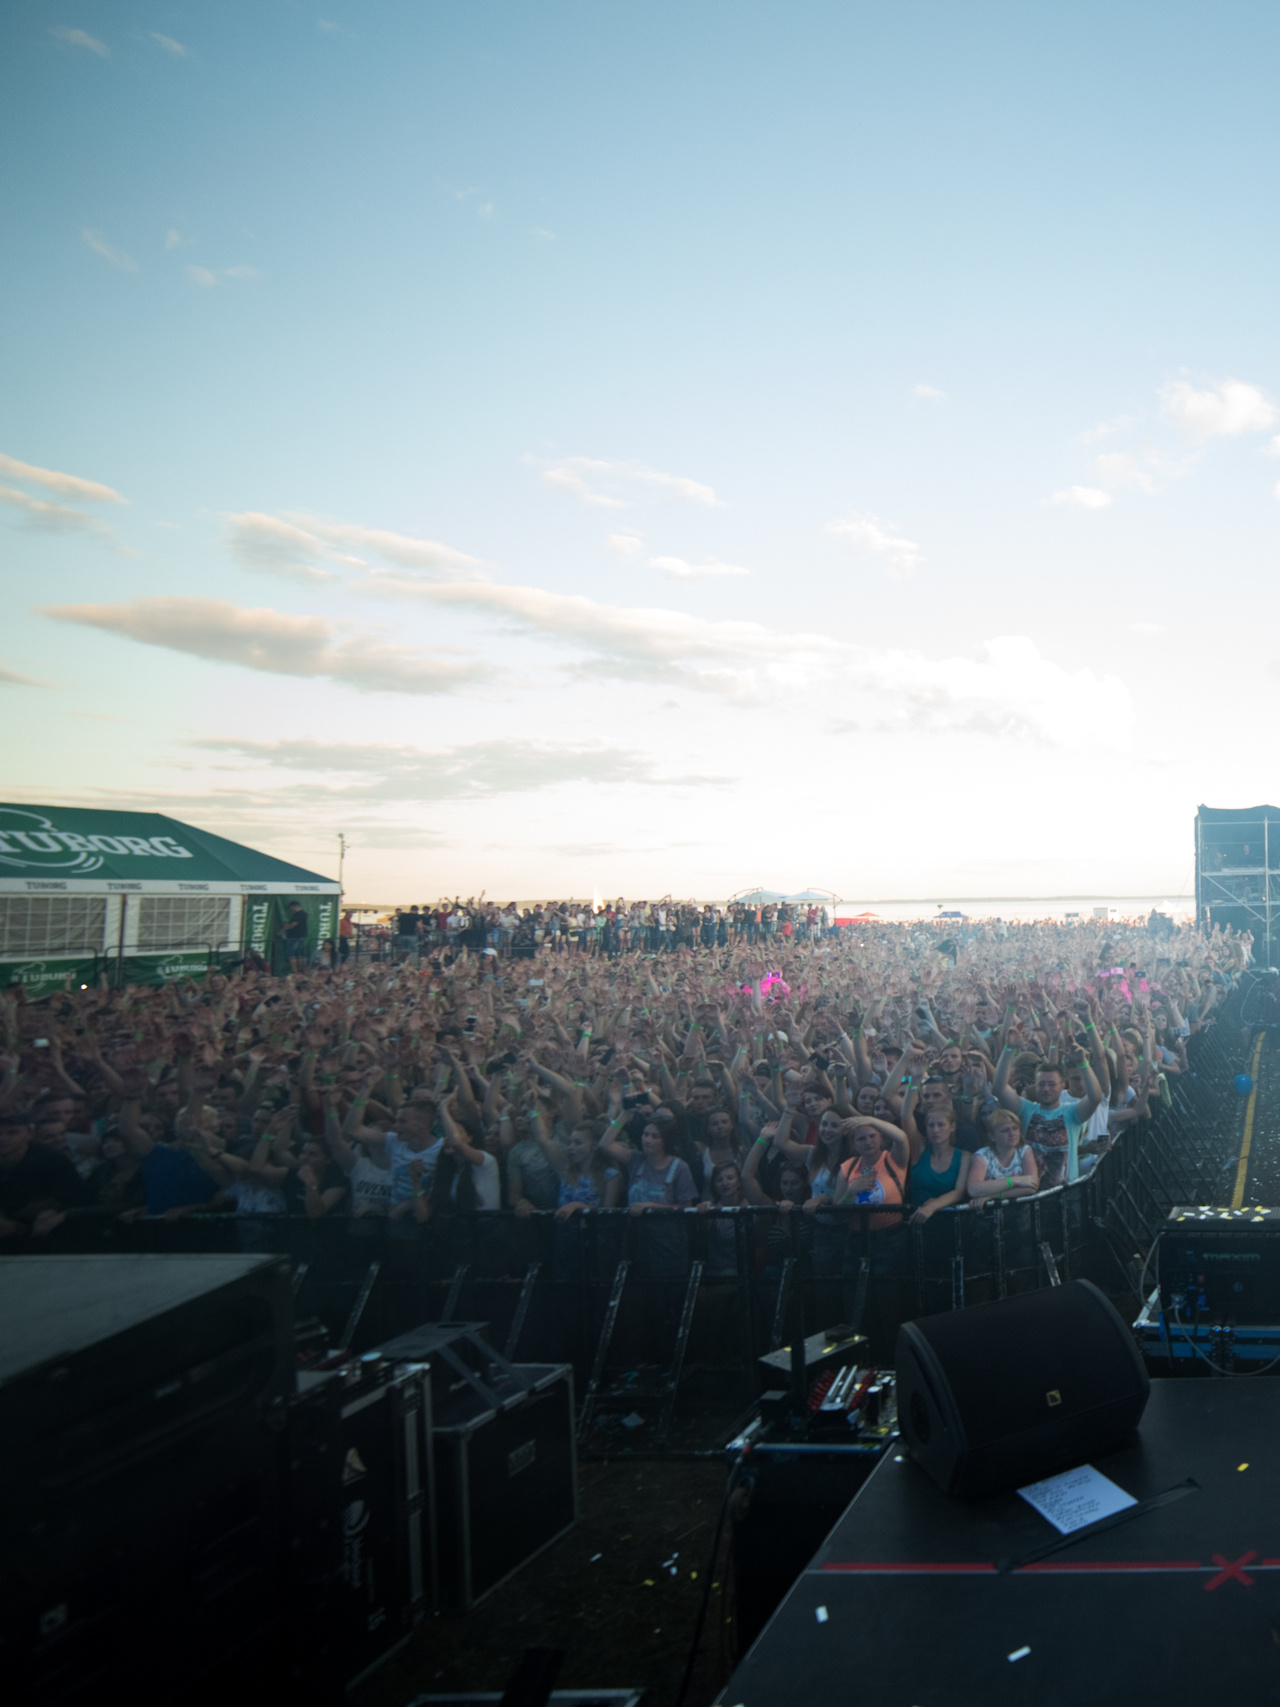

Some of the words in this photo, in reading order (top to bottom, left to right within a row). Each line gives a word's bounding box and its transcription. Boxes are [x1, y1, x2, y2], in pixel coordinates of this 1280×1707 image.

[26, 881, 67, 890] TUBORG
[107, 882, 142, 891] TUBORG
[178, 883, 210, 892] TUBORG
[251, 902, 268, 958] TUBOR
